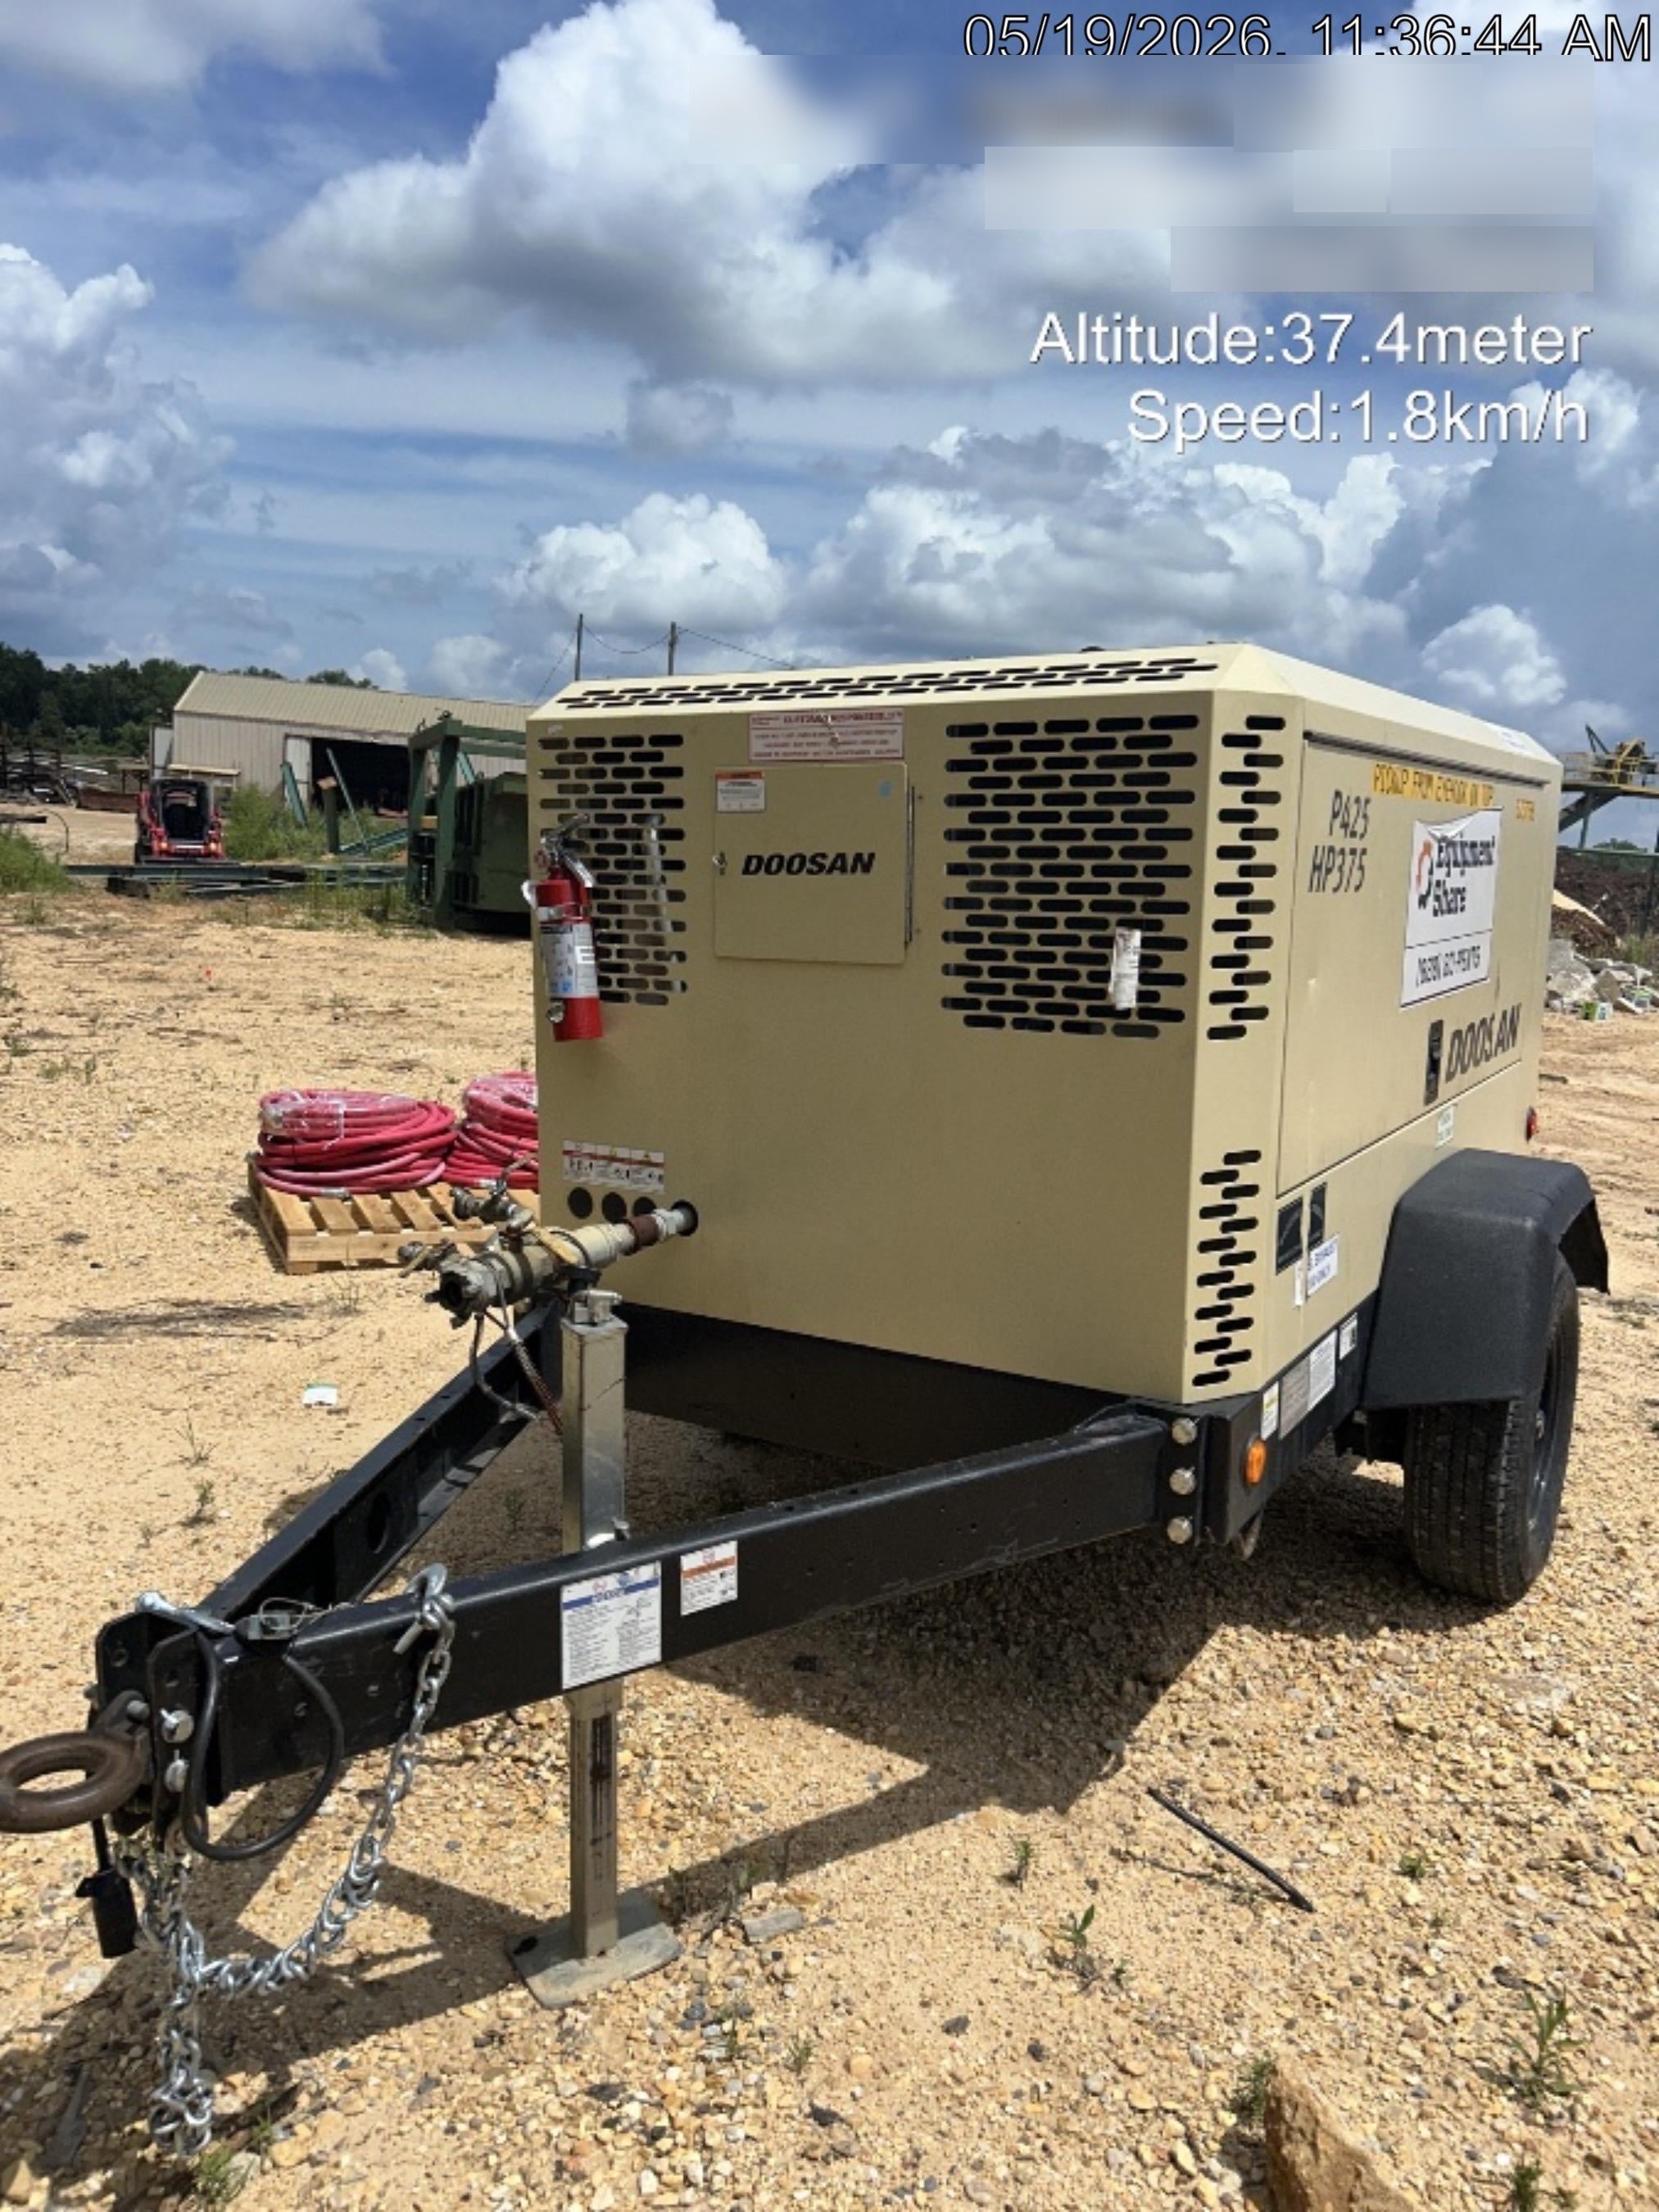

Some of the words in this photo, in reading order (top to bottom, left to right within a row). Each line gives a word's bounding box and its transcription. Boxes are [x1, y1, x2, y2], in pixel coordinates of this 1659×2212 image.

[1329, 789, 1371, 840] P425
[741, 852, 876, 877] DOOSAN
[1308, 845, 1367, 893] HP375
[1433, 879, 1466, 917] Share
[1445, 1003, 1522, 1083] DOOSAN
